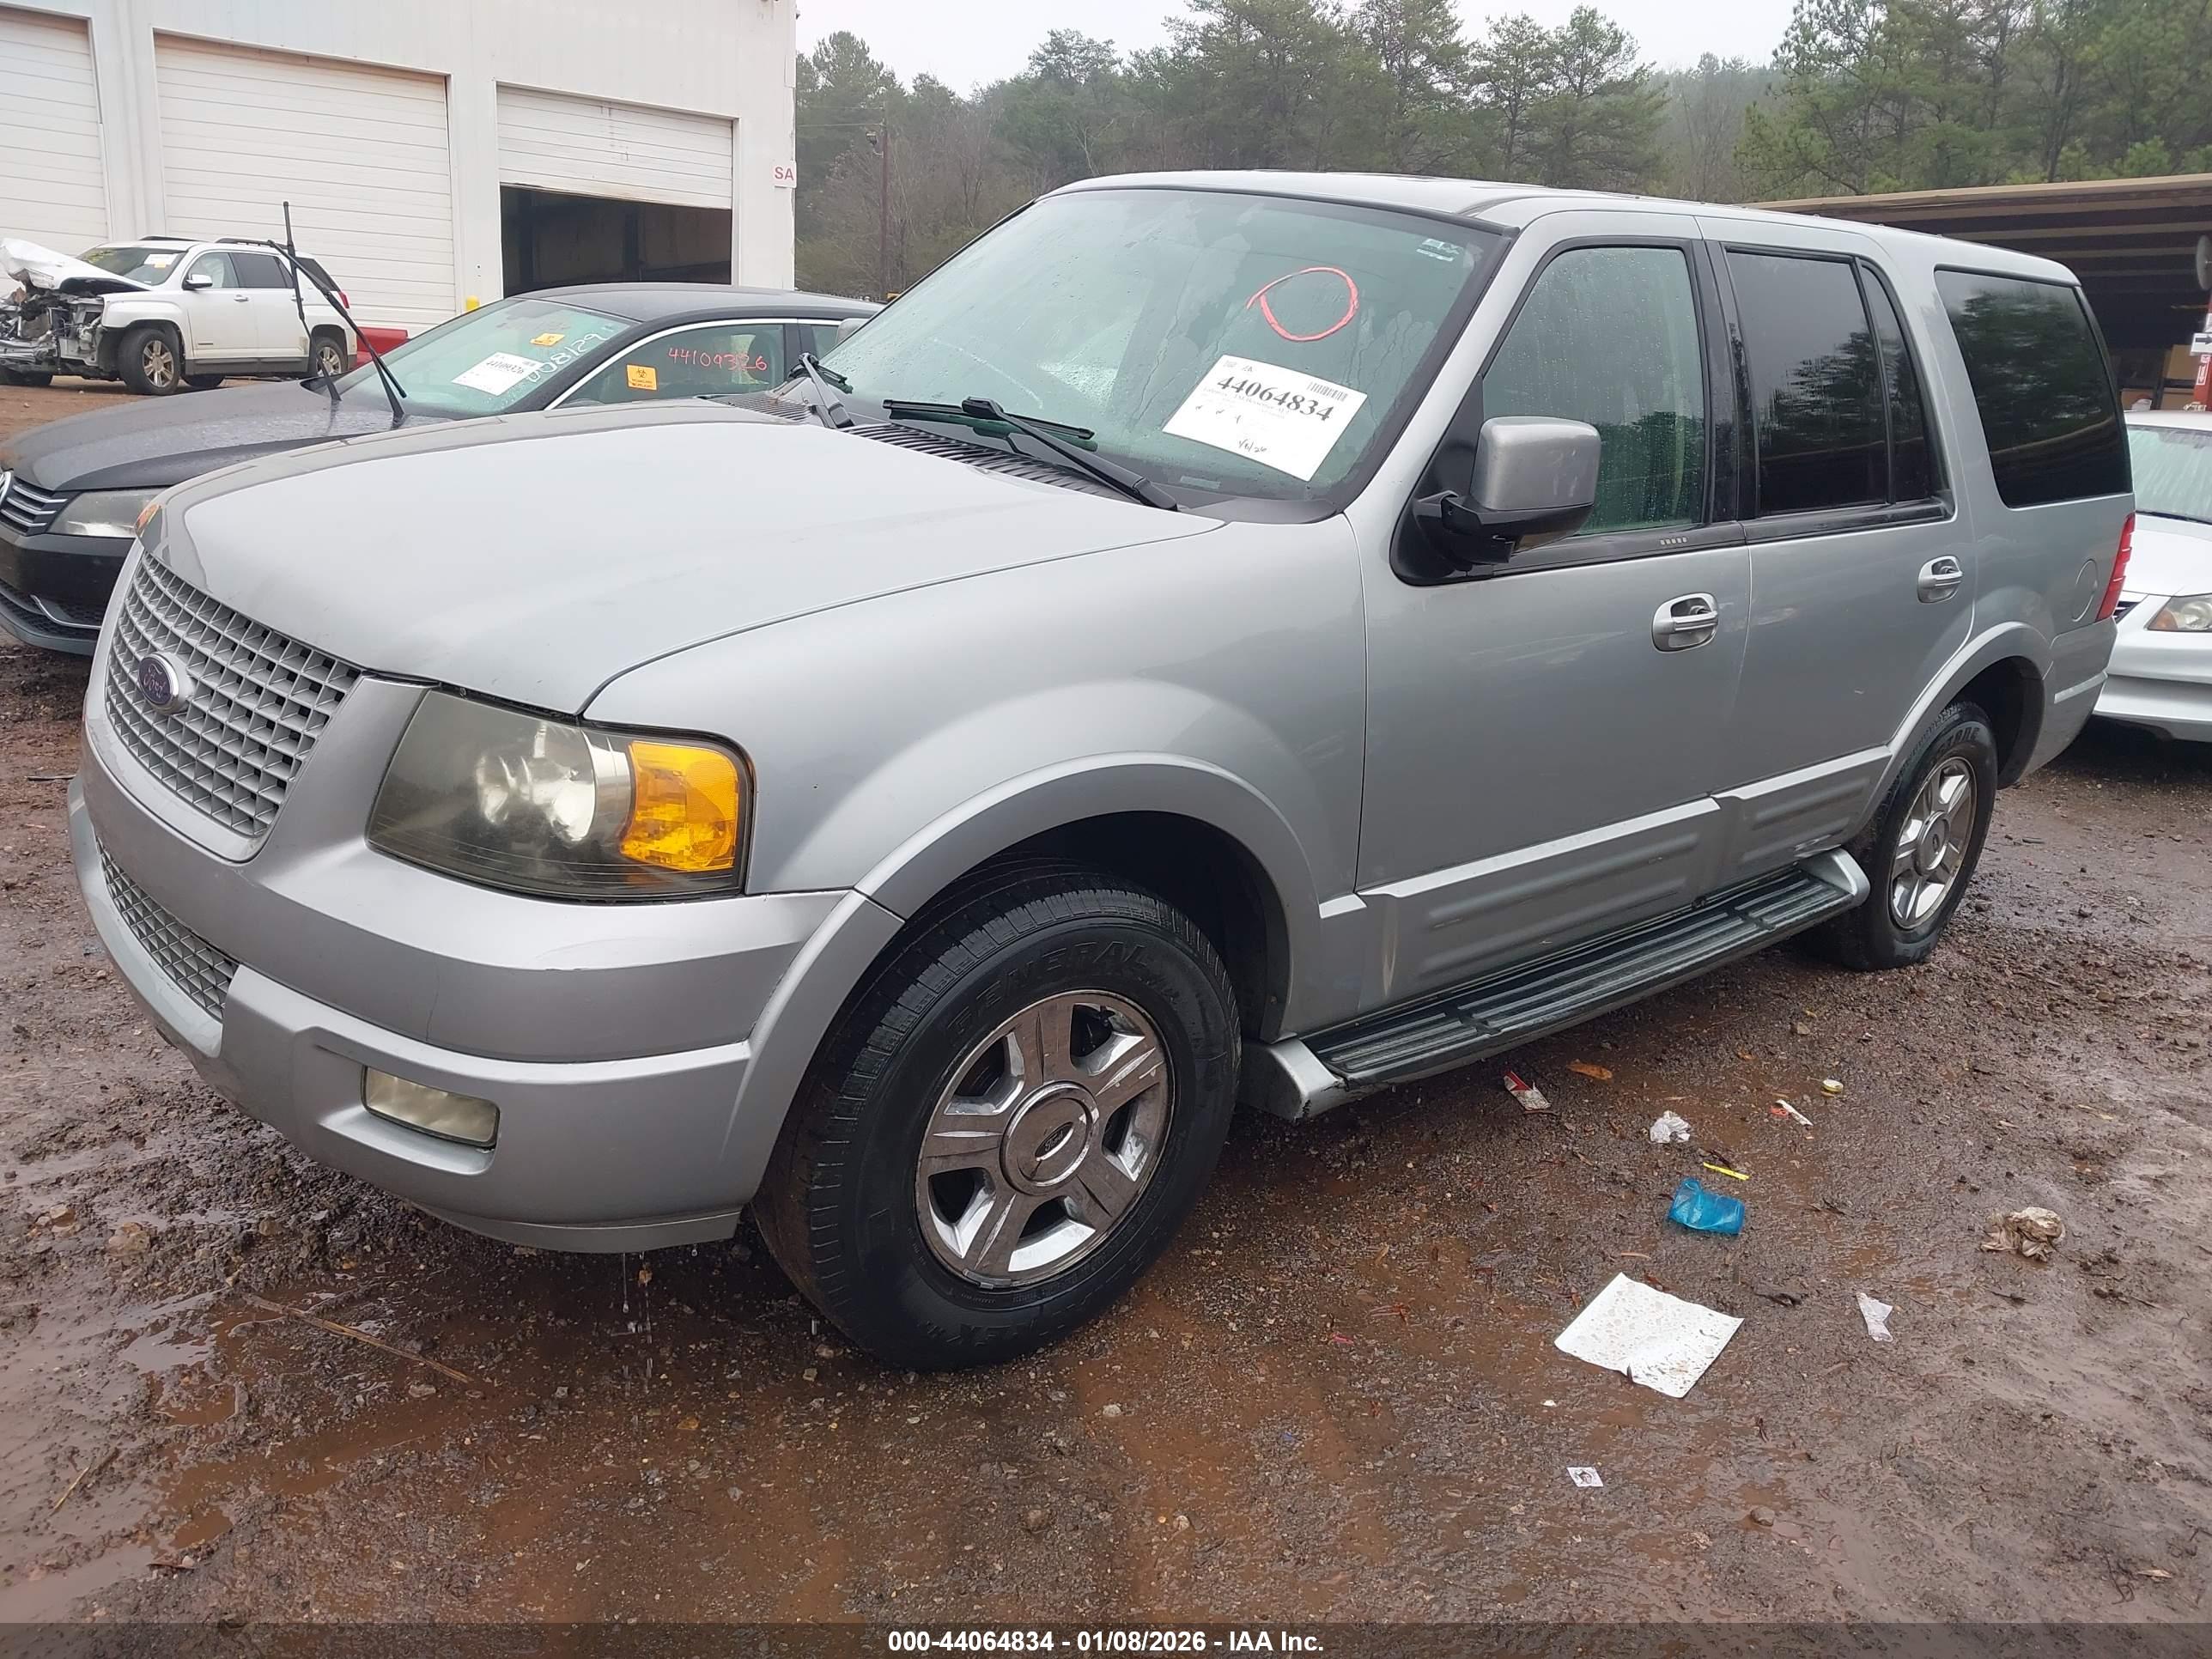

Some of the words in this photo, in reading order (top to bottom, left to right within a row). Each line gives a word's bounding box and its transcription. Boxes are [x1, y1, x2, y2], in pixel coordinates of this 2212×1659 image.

[775, 166, 794, 181] SA
[668, 347, 768, 371] 44109326
[1217, 376, 1334, 422] 44064834
[947, 941, 1151, 1039] GENERAL
[1044, 1129, 1065, 1152] Ford
